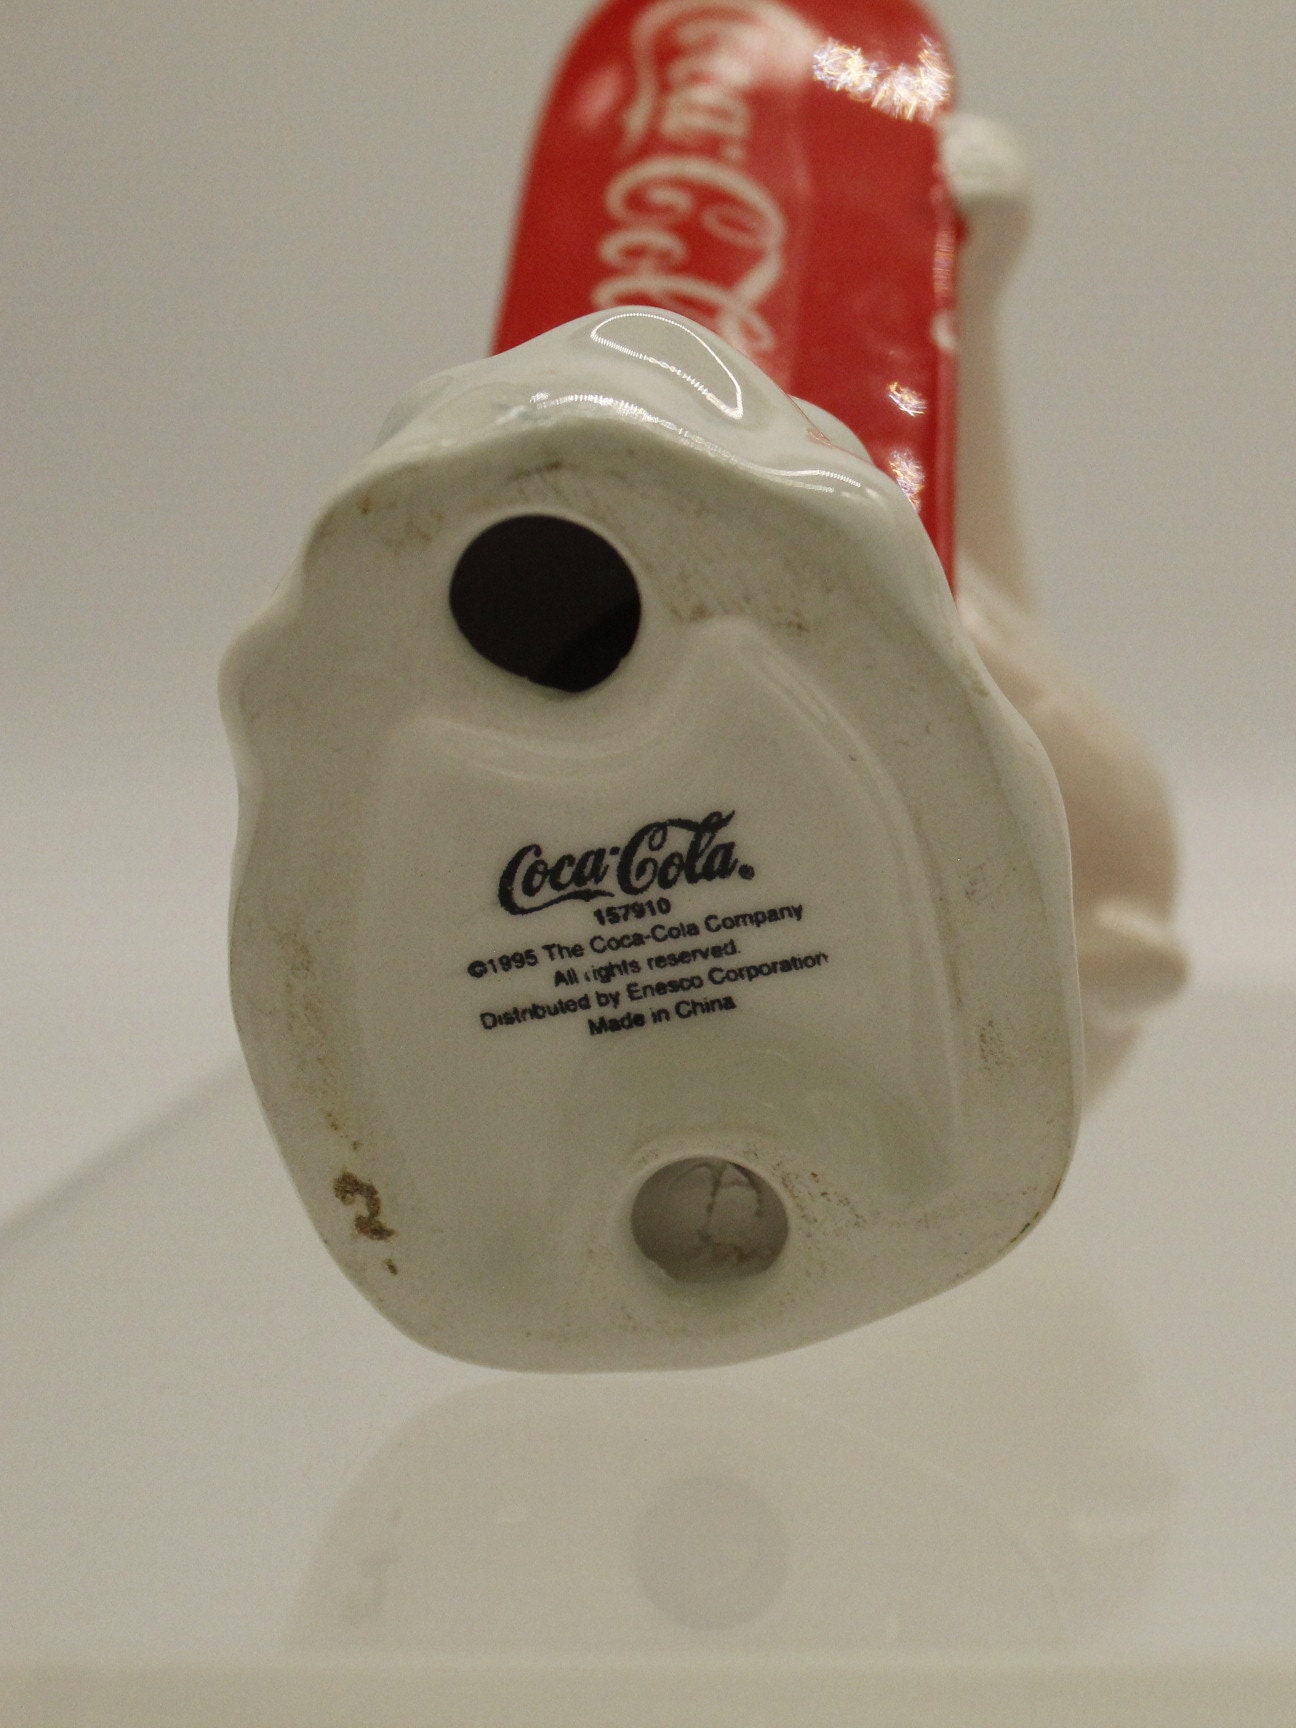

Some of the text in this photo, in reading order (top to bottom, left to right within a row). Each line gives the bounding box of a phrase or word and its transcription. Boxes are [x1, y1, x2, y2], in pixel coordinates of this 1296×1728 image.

[498, 810, 741, 915] Coca-Cola
[542, 942, 585, 962] The
[590, 922, 700, 954] Coca-Cola
[704, 904, 804, 933] Company
[593, 897, 671, 925] 157910
[554, 968, 580, 987] All
[647, 939, 741, 970] reserved.
[479, 951, 829, 1030] Distributed by Enesco Corporation
[587, 996, 737, 1036] Made in China
